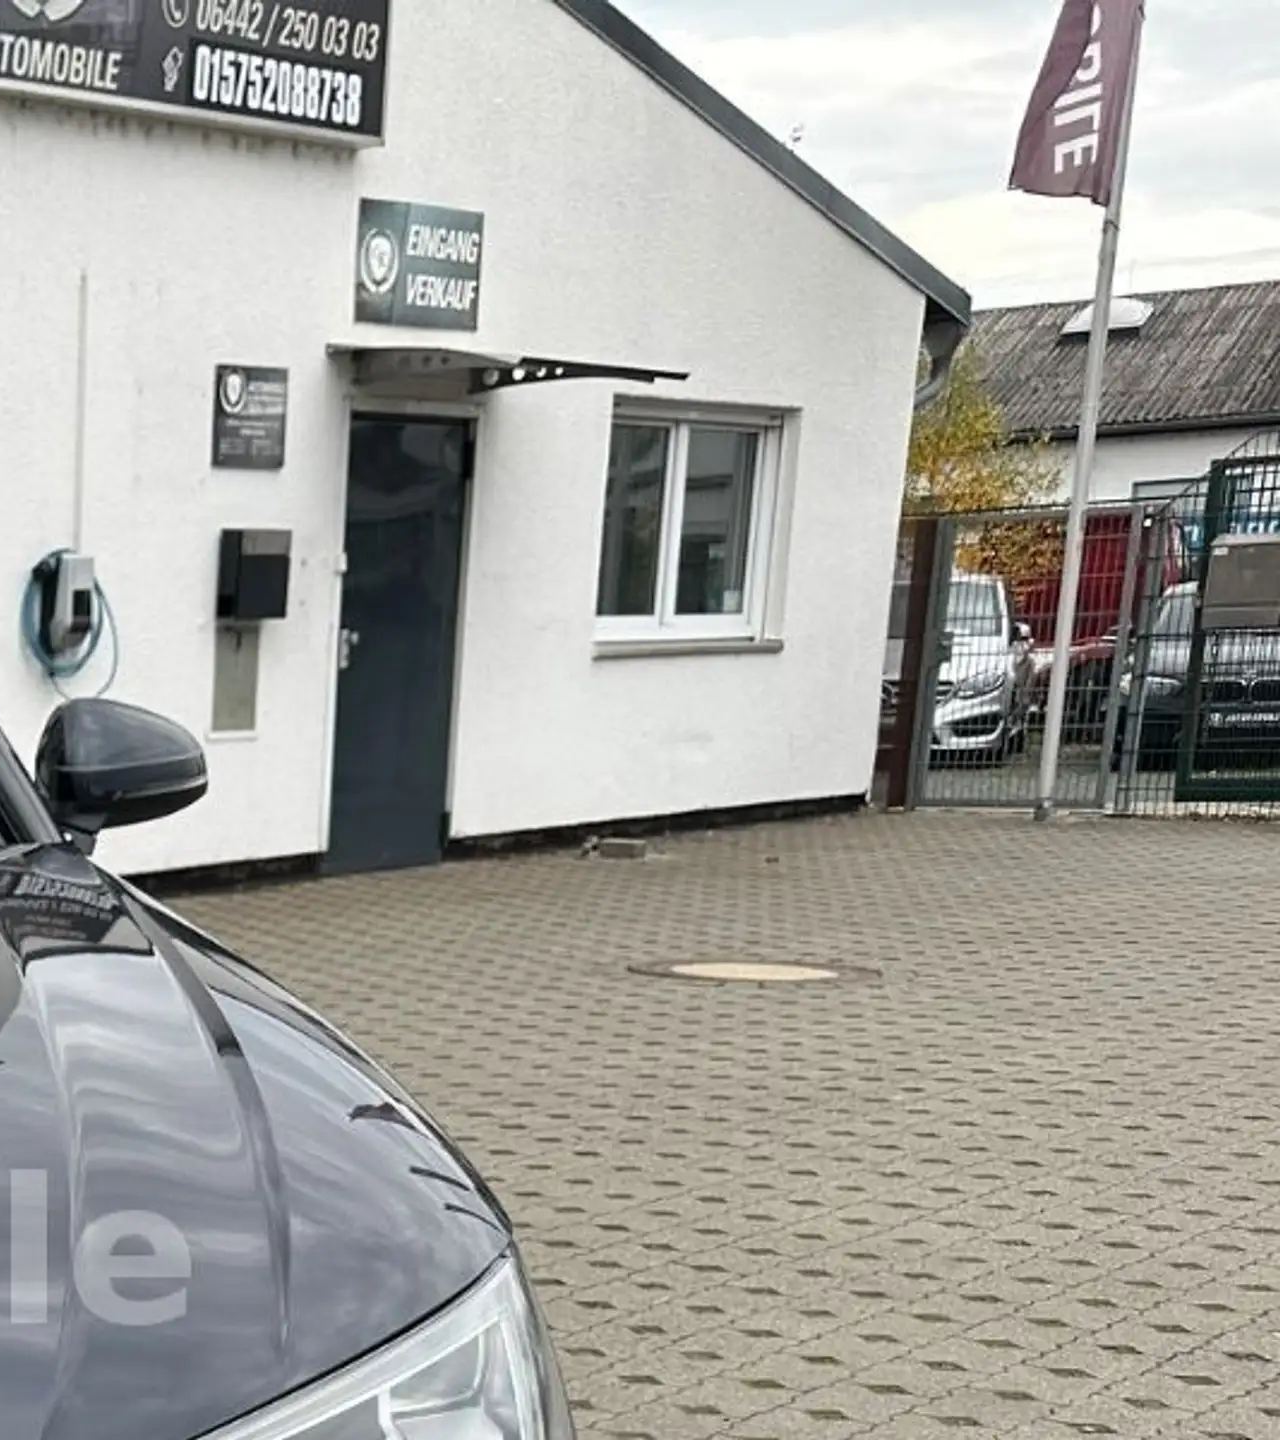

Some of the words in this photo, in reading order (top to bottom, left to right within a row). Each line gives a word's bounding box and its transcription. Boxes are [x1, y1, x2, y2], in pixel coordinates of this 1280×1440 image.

[195, 0, 264, 40] 06442
[278, 7, 319, 52] 250
[322, 16, 349, 56] 03
[352, 21, 380, 61] 03
[193, 44, 362, 127] 015752088738
[406, 224, 480, 264] EINGANG
[405, 273, 478, 311] VERKAUF
